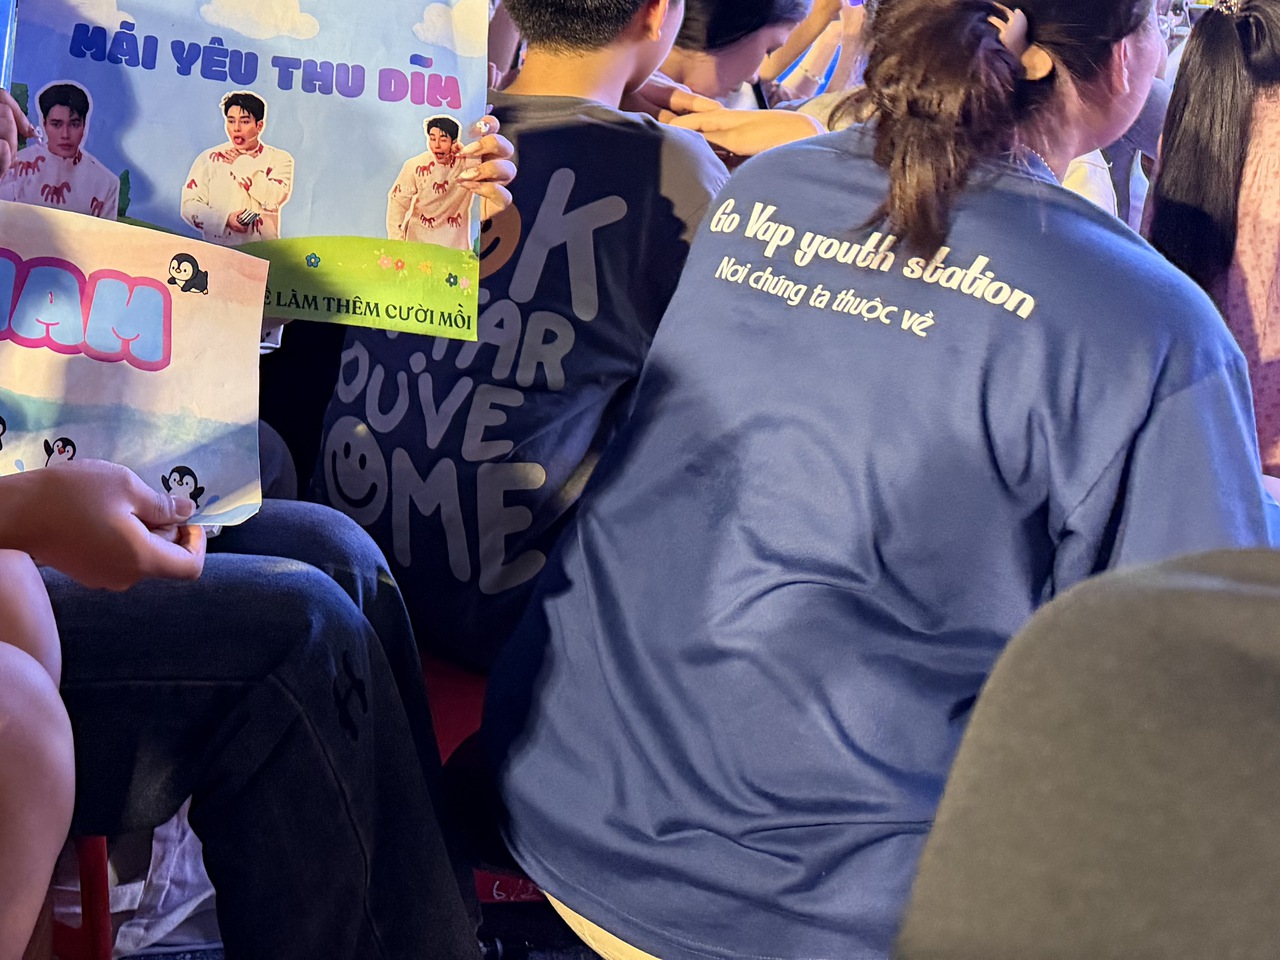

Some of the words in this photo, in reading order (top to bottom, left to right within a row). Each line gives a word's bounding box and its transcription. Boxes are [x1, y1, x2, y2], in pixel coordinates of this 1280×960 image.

[69, 20, 159, 71] MÃI
[170, 37, 259, 86] YÊU
[271, 55, 365, 98] THU
[377, 54, 462, 110] DĨM
[709, 198, 741, 233] Go
[745, 201, 796, 258] Vap
[794, 231, 896, 273] youth
[902, 246, 1036, 319] station
[276, 288, 320, 312] LÀM
[322, 295, 381, 318] THÊM
[384, 303, 434, 325] CƯỜI
[438, 302, 472, 330] MỒI
[808, 284, 831, 309] ta
[831, 289, 898, 326] thuộc
[900, 309, 936, 338] về
